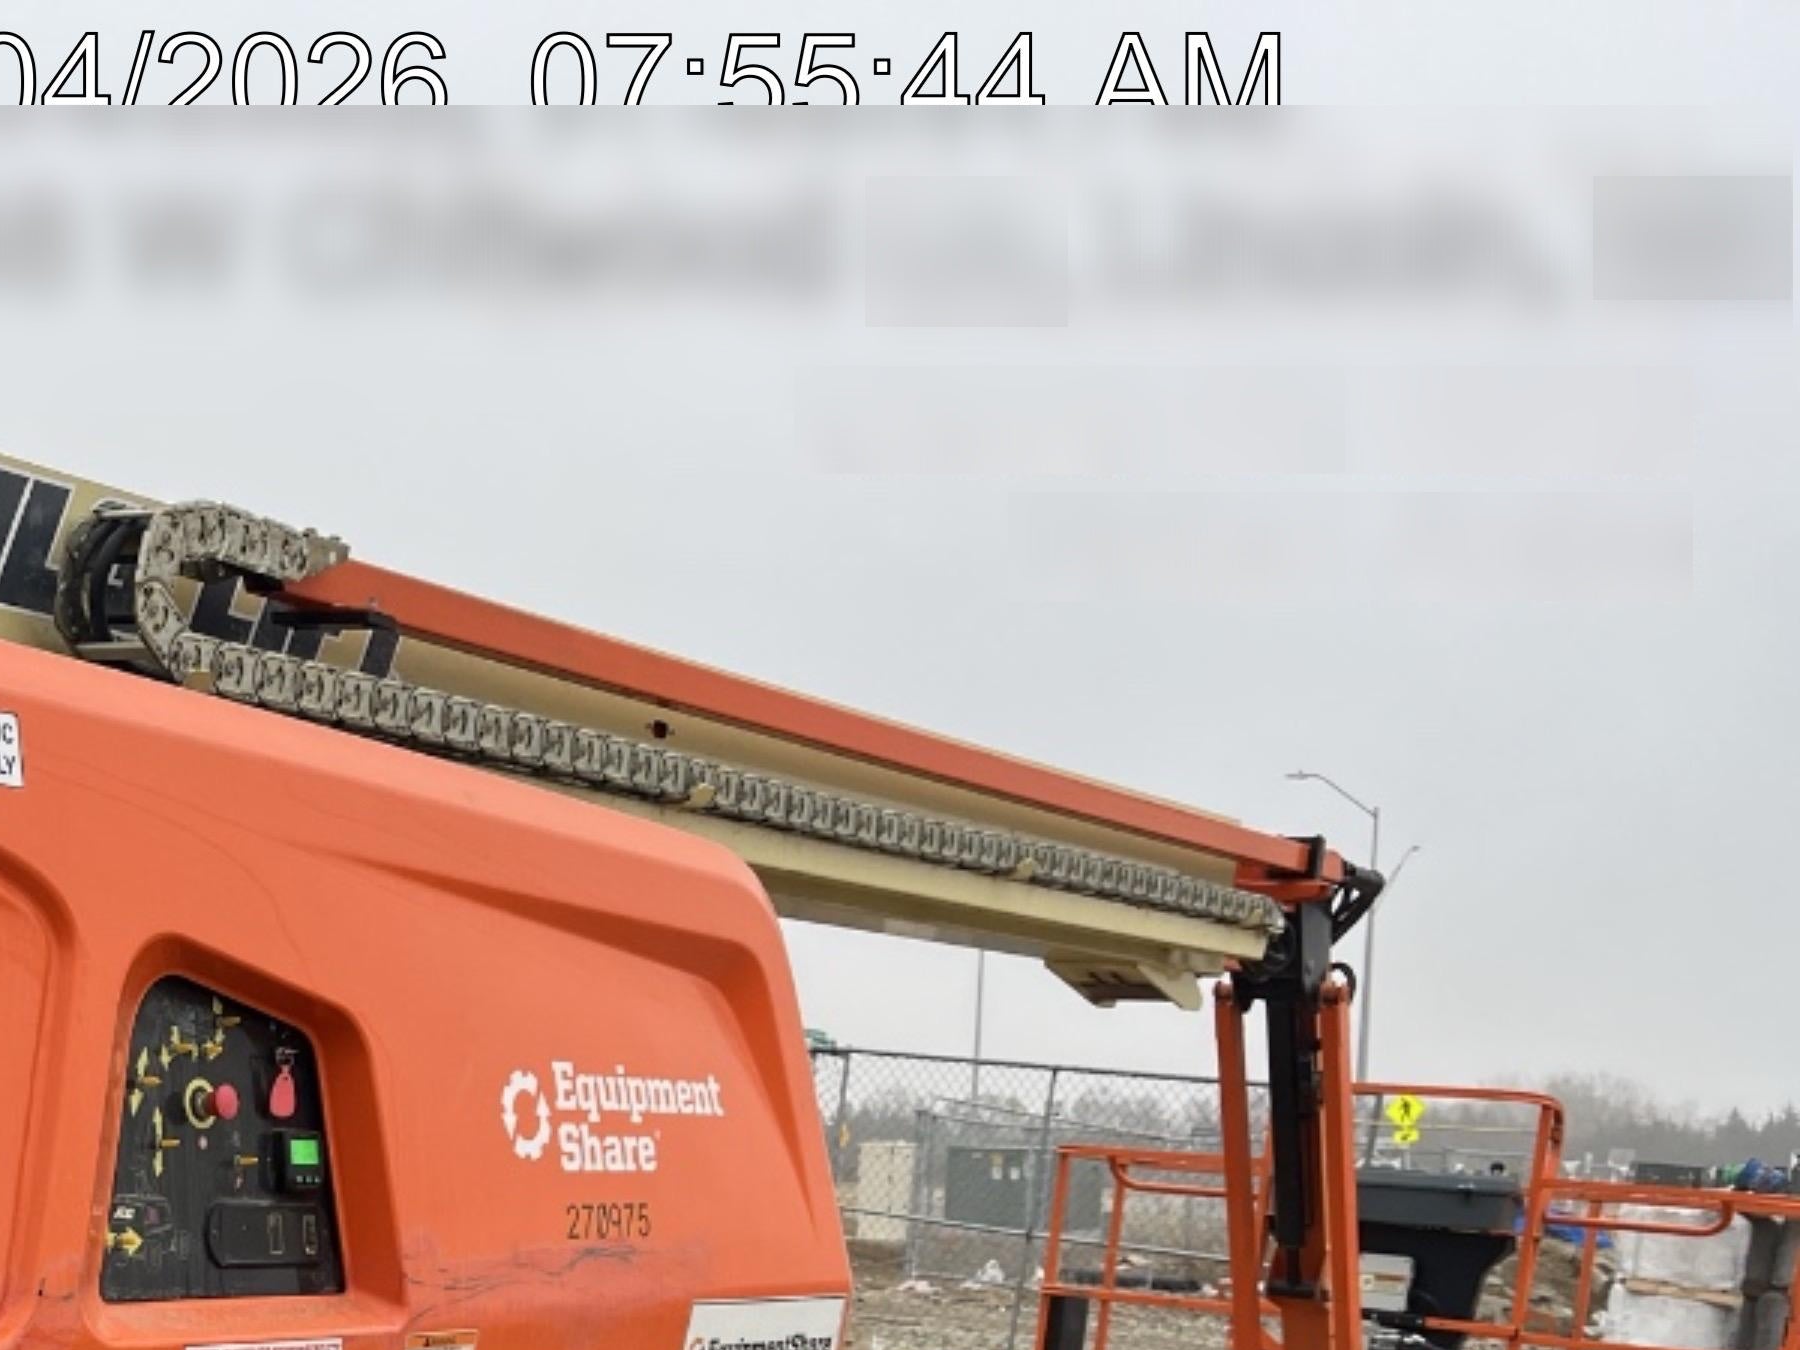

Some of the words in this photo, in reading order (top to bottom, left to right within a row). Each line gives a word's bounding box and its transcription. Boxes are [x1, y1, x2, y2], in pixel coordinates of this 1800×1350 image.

[551, 1061, 725, 1123] Equipment
[556, 1121, 659, 1172] Share
[566, 1202, 652, 1240] 270975
